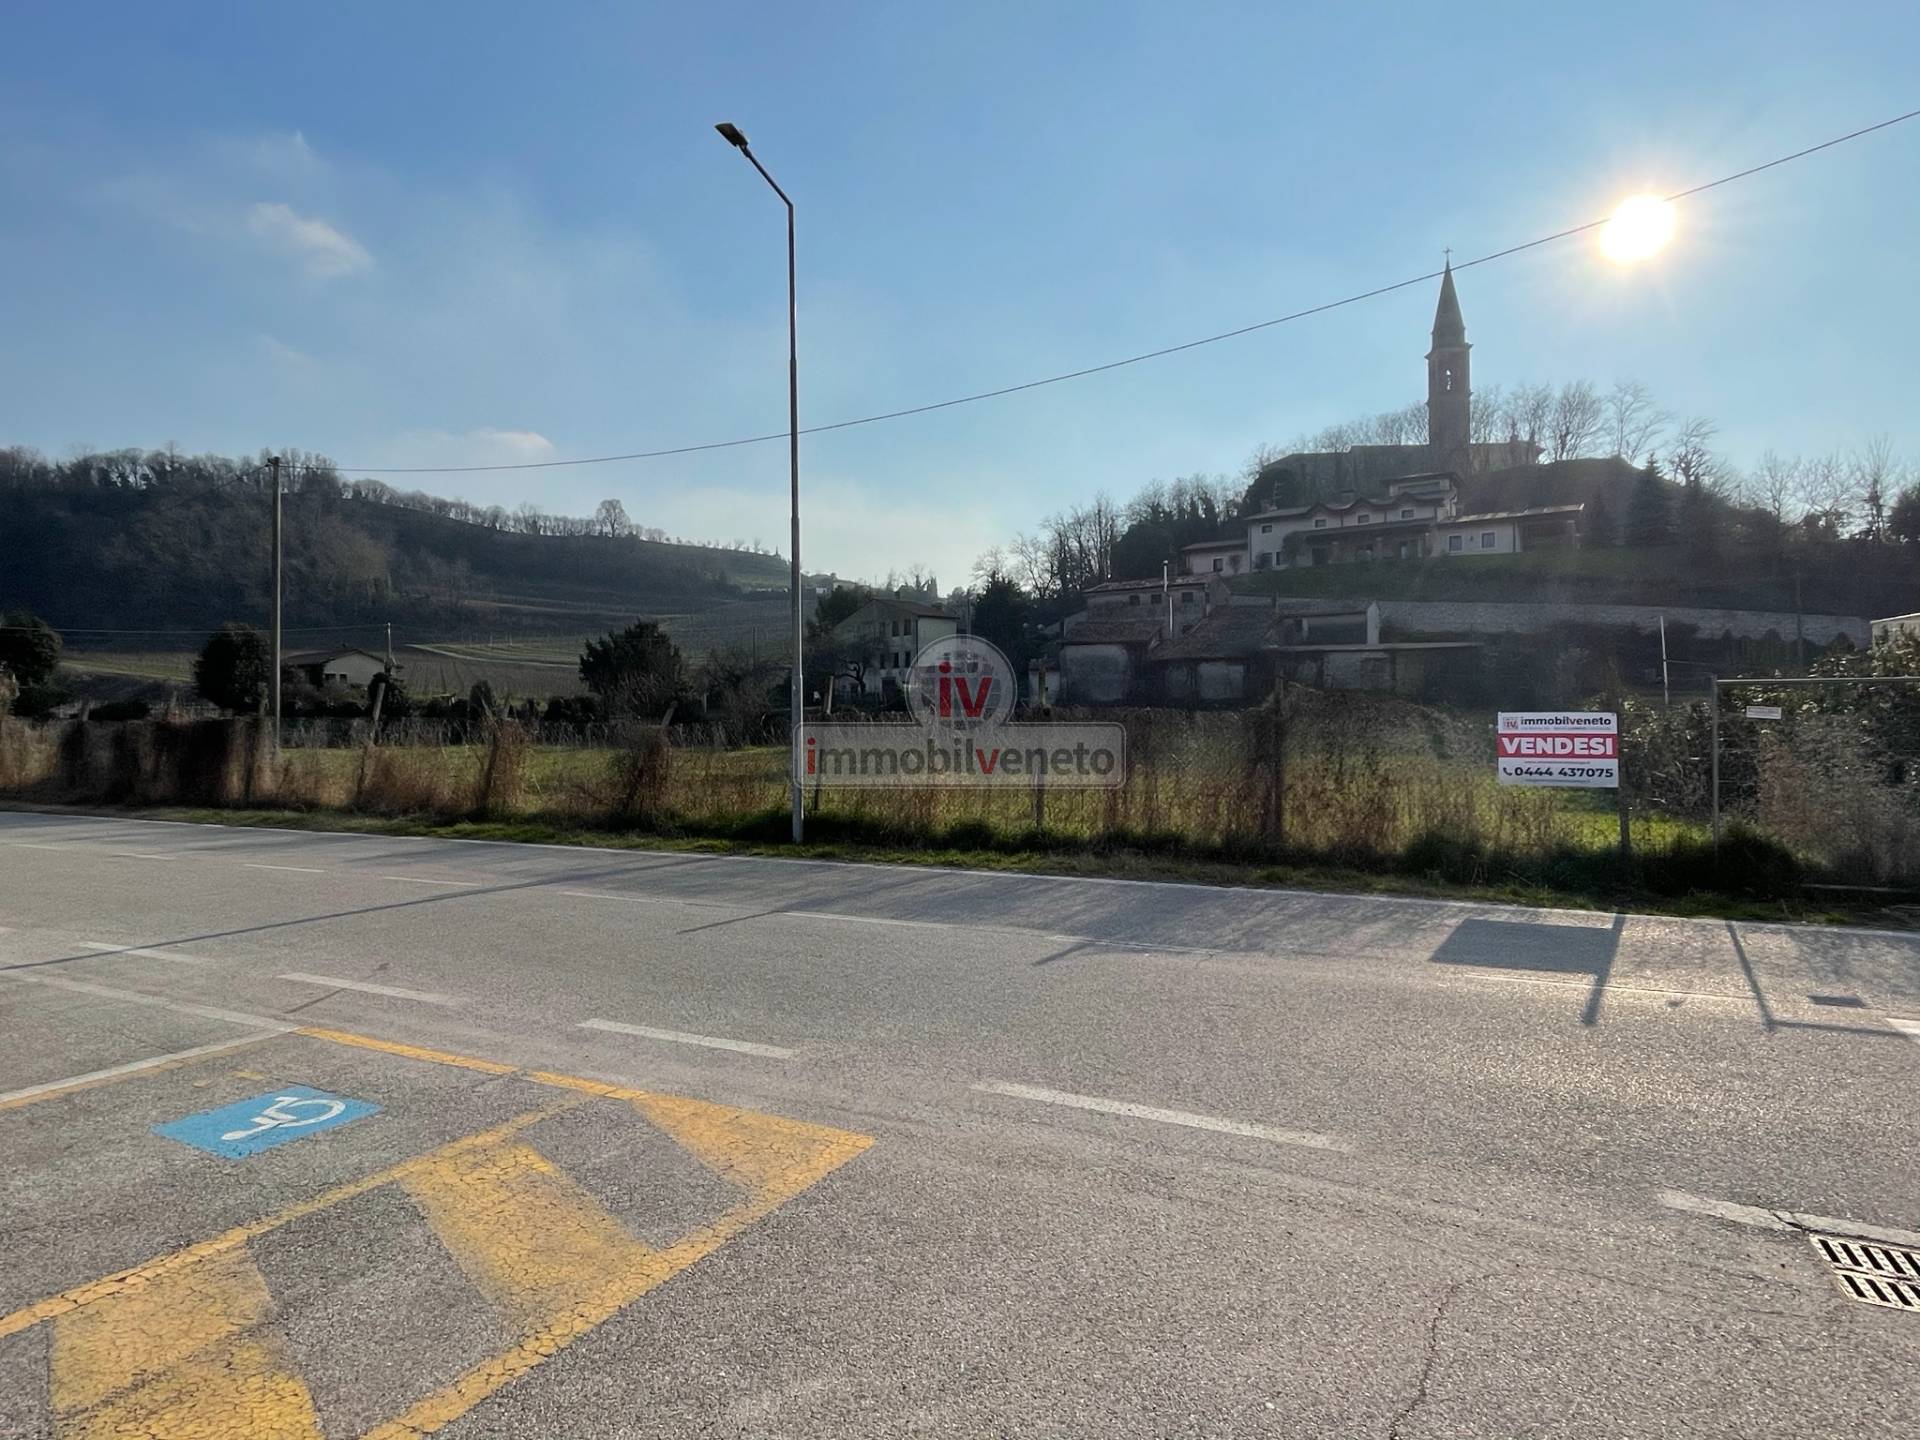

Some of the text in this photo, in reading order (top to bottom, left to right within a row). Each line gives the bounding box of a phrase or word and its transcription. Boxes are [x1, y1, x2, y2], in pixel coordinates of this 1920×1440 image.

[1520, 716, 1612, 726] immobilveneto
[1501, 737, 1614, 755] VENDESI
[1514, 766, 1614, 778] 0444 437075
